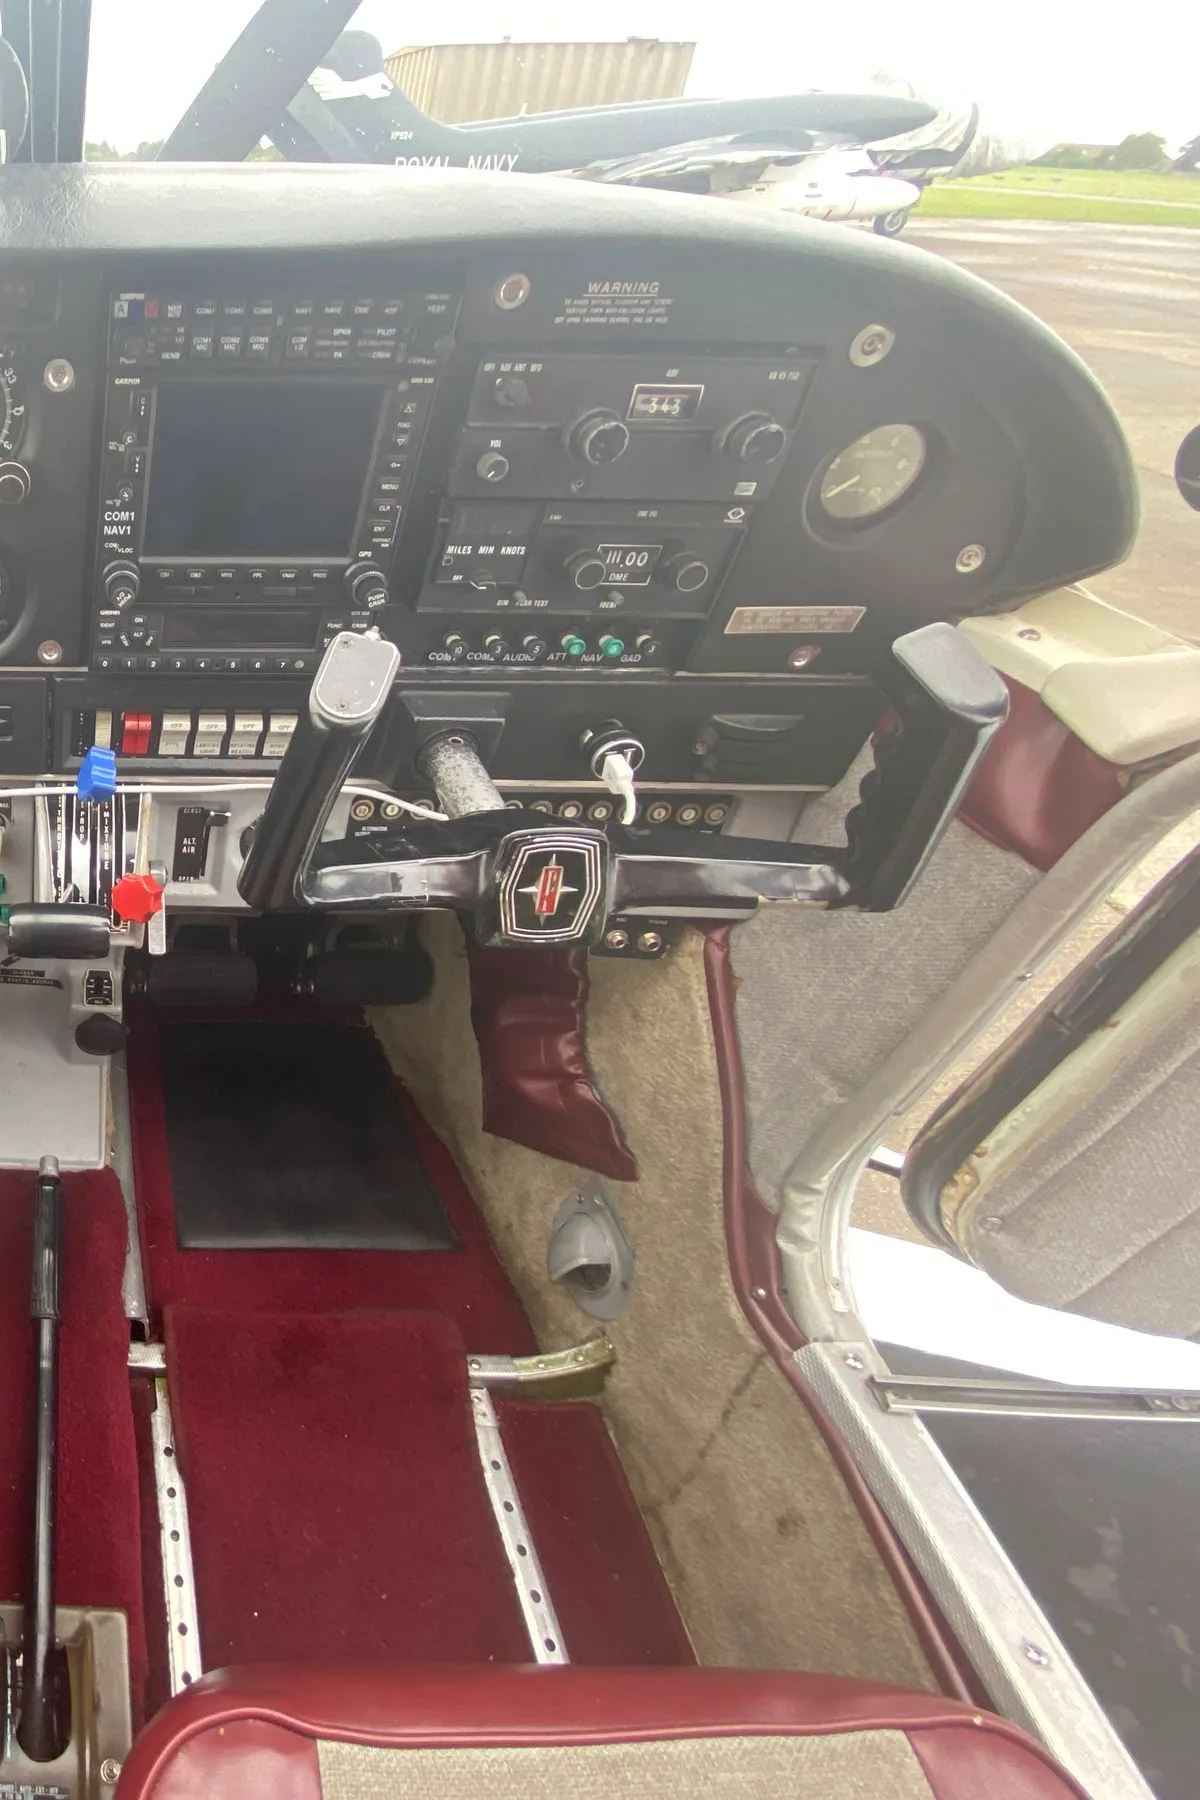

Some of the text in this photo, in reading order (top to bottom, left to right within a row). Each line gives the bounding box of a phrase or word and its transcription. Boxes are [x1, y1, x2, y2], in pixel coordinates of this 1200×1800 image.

[390, 130, 413, 141] XP924
[467, 153, 519, 172] NAVY
[588, 280, 660, 294] WARNING
[4, 367, 17, 384] 33
[114, 377, 141, 385] GARMIN
[648, 397, 681, 415] 343
[381, 483, 400, 491] MENU
[104, 511, 135, 522] COM1
[103, 525, 131, 536] NAV1
[358, 550, 373, 558] GPS
[446, 545, 526, 555] MILES MIN KNOTS
[608, 572, 629, 581] DME
[367, 592, 385, 602] PUSH
[533, 645, 541, 653] 5
[546, 652, 568, 661] ATT
[580, 653, 604, 662] NAV
[102, 660, 109, 668] 0
[150, 660, 157, 668] 2
[175, 660, 181, 668] 3
[199, 660, 205, 668] 4
[230, 660, 236, 668] 5
[255, 660, 261, 668] 6
[280, 660, 286, 668] 7
[182, 837, 197, 845] ALT.
[181, 846, 196, 854] AIR
